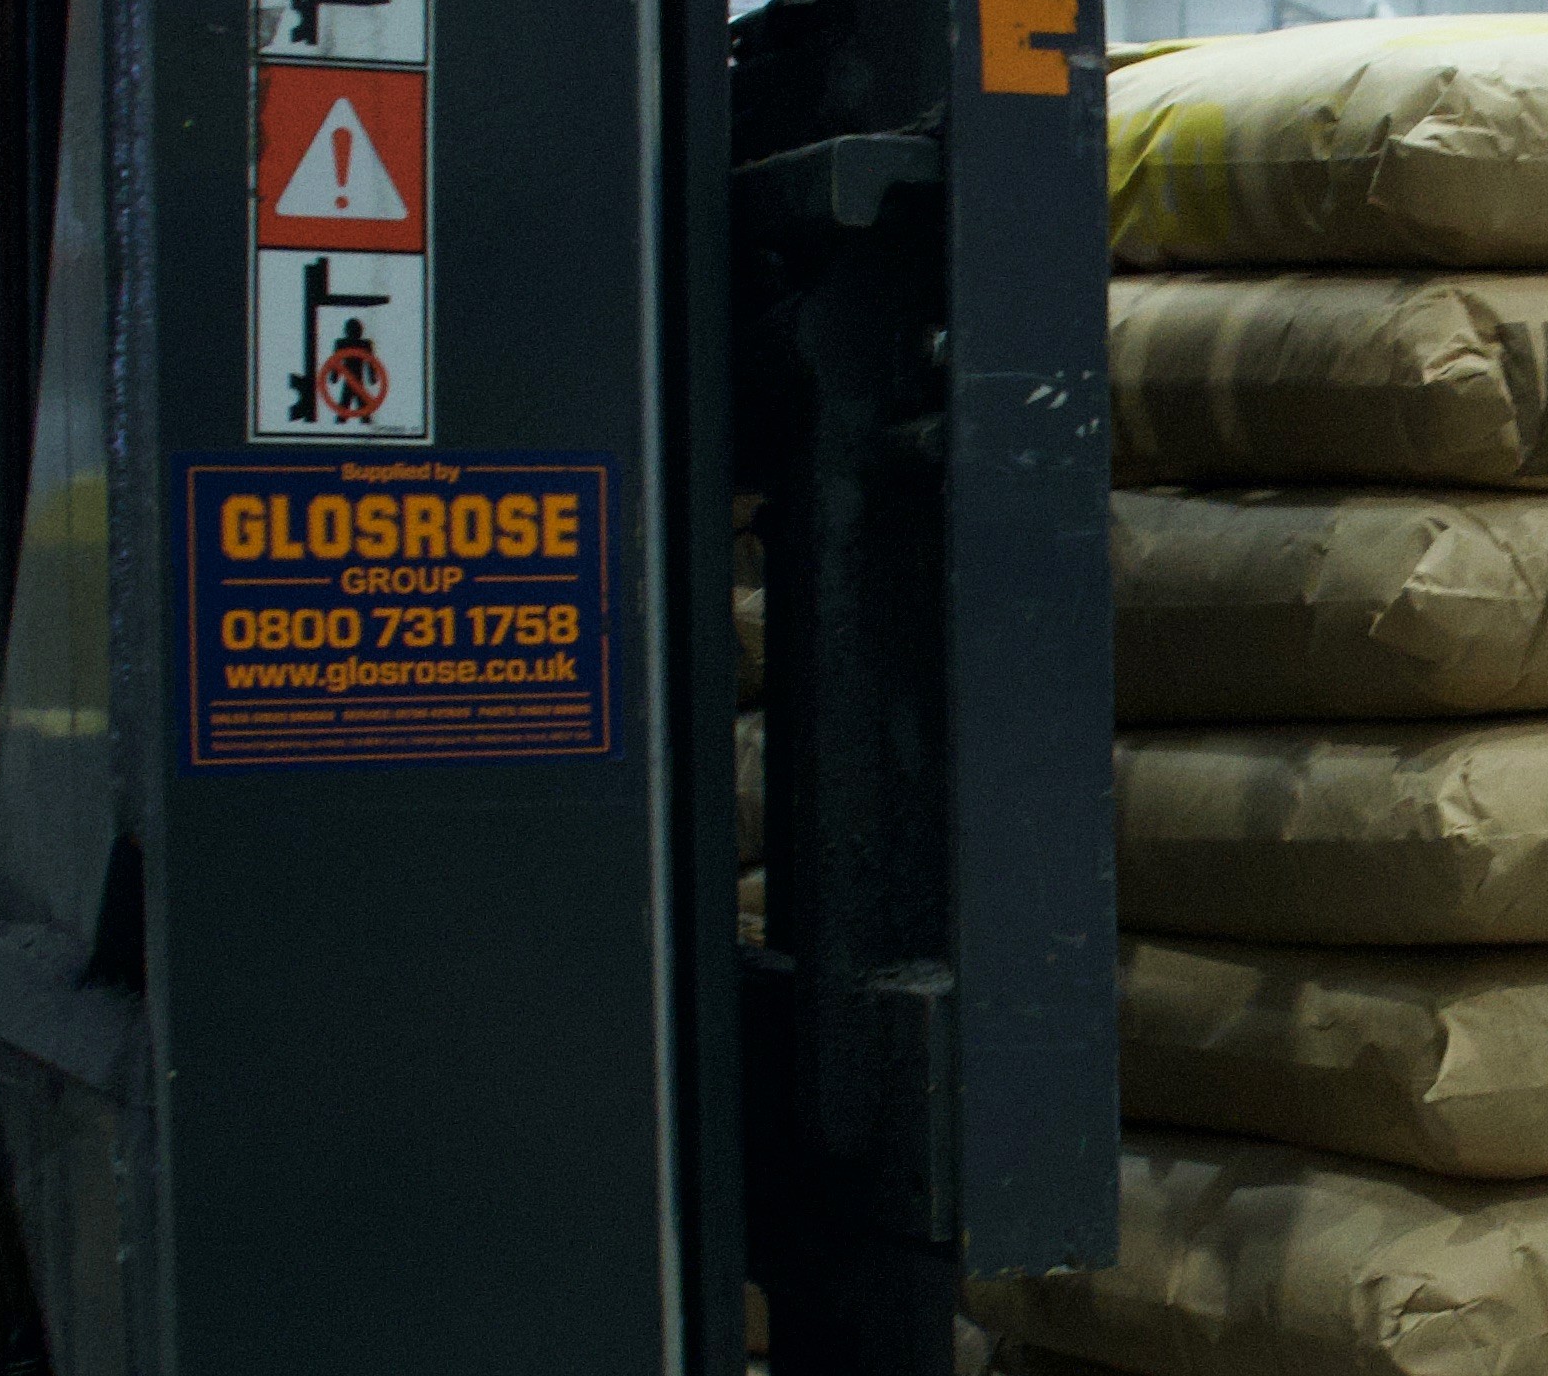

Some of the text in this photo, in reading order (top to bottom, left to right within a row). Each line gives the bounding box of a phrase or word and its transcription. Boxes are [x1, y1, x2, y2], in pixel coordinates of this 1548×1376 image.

[340, 461, 461, 485] Supplied by
[219, 491, 581, 562] GLOSROSE
[339, 565, 465, 595] GROUP
[220, 603, 581, 651] 0800 731 1758
[223, 651, 578, 693] www.glosrose.co.uk
